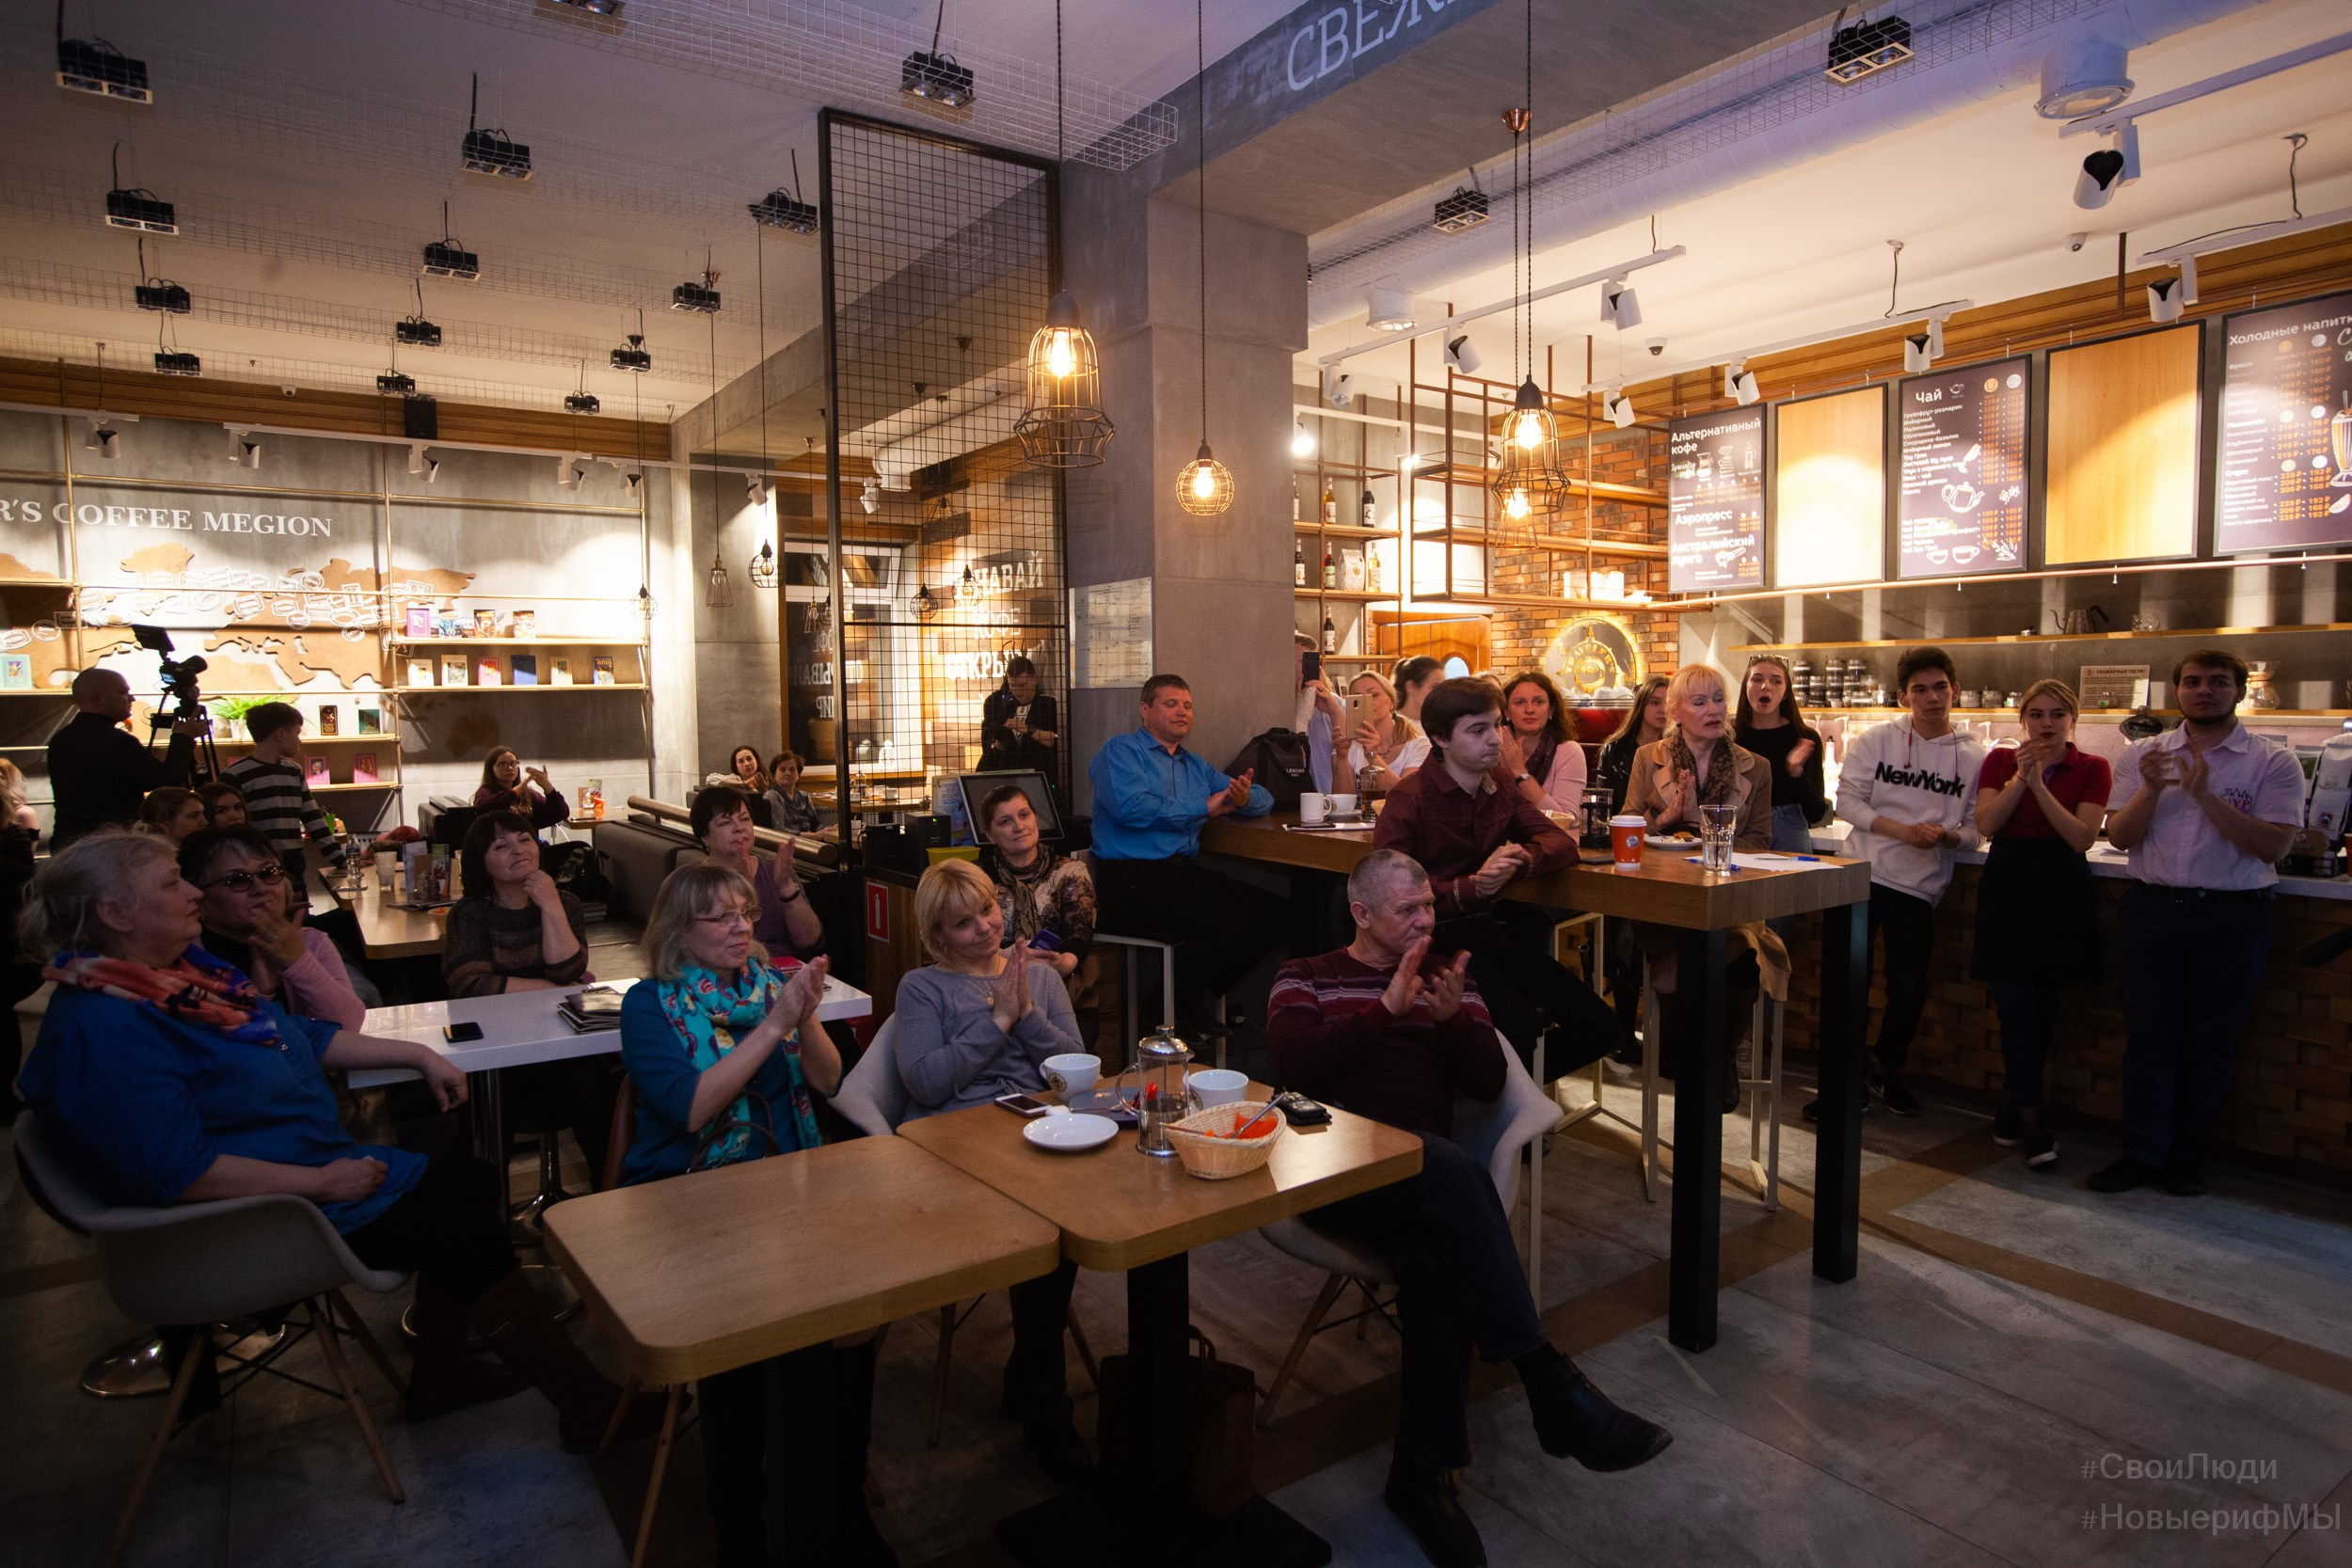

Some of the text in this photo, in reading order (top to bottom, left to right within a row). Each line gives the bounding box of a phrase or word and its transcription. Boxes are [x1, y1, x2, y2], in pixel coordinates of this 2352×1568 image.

[2230, 326, 2298, 345] Холодные
[1915, 388, 1942, 403] Чай
[1672, 418, 1761, 441] Альтернативный
[1671, 442, 1697, 454] кофе
[53, 503, 194, 530] COFFEE
[202, 511, 332, 537] MEGION
[1676, 511, 1732, 526] Аэропресс
[1672, 535, 1755, 556] Австралийский
[1875, 761, 1965, 799] NewYork
